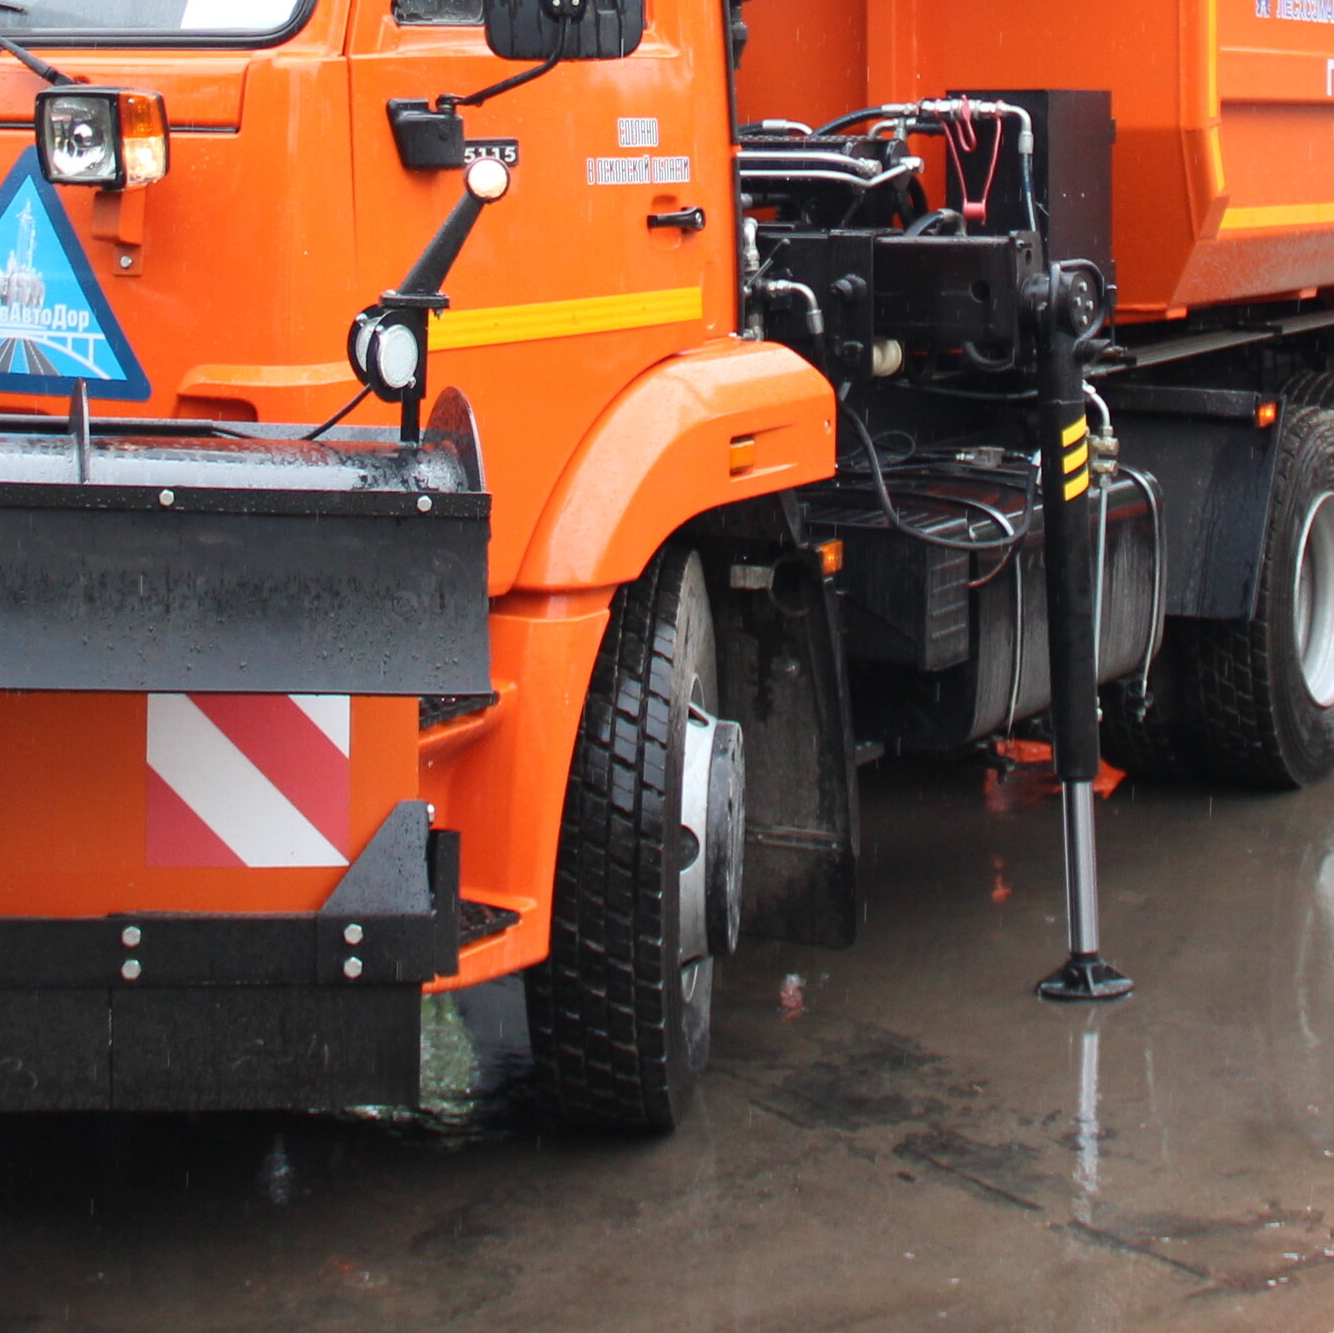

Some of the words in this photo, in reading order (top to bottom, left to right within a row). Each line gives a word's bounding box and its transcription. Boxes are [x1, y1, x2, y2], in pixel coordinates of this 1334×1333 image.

[618, 117, 658, 147] СДЕЛАНО
[587, 158, 595, 185] В
[596, 154, 650, 185] ПСКОВСКОЙ
[652, 156, 690, 184] ОБЛАСТИ
